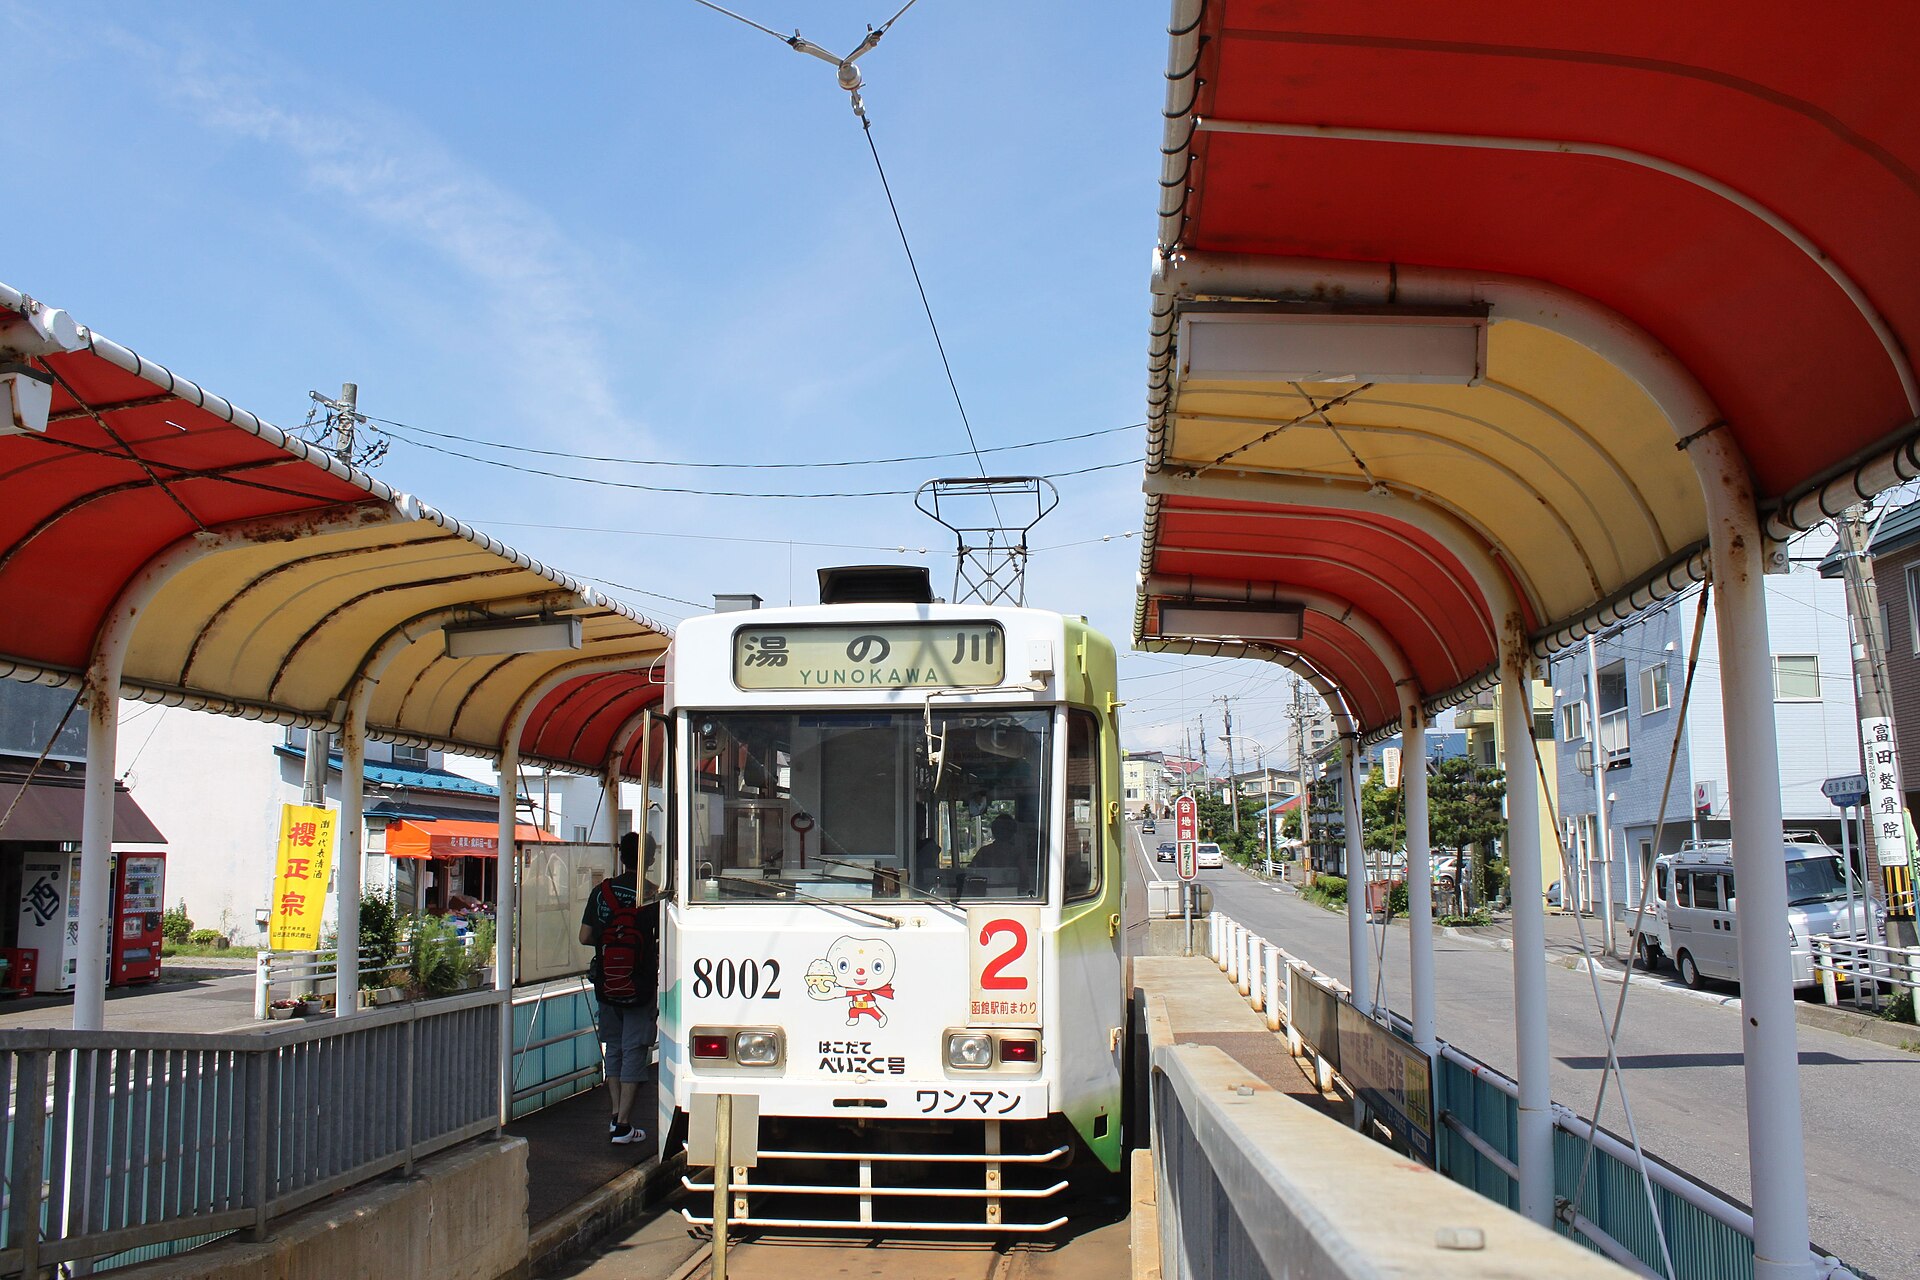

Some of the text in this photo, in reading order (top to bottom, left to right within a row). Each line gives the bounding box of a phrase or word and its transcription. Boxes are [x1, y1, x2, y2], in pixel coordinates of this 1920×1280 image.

[743, 632, 996, 668] 湯の川
[800, 668, 938, 685] YUNOKAWA
[961, 716, 1028, 727] ワンマン
[1872, 722, 1901, 840] 富田整骨院
[1180, 802, 1192, 840] 谷地頭
[279, 822, 317, 917] 櫻正宗
[22, 876, 61, 927] 酒
[979, 918, 1028, 990] 2
[692, 957, 782, 1000] 8002
[971, 1001, 1037, 1016] 函館駅前まわり
[818, 1040, 872, 1055] はこだて
[819, 1056, 906, 1075] べいこく号
[916, 1089, 1021, 1115] ワンマン
